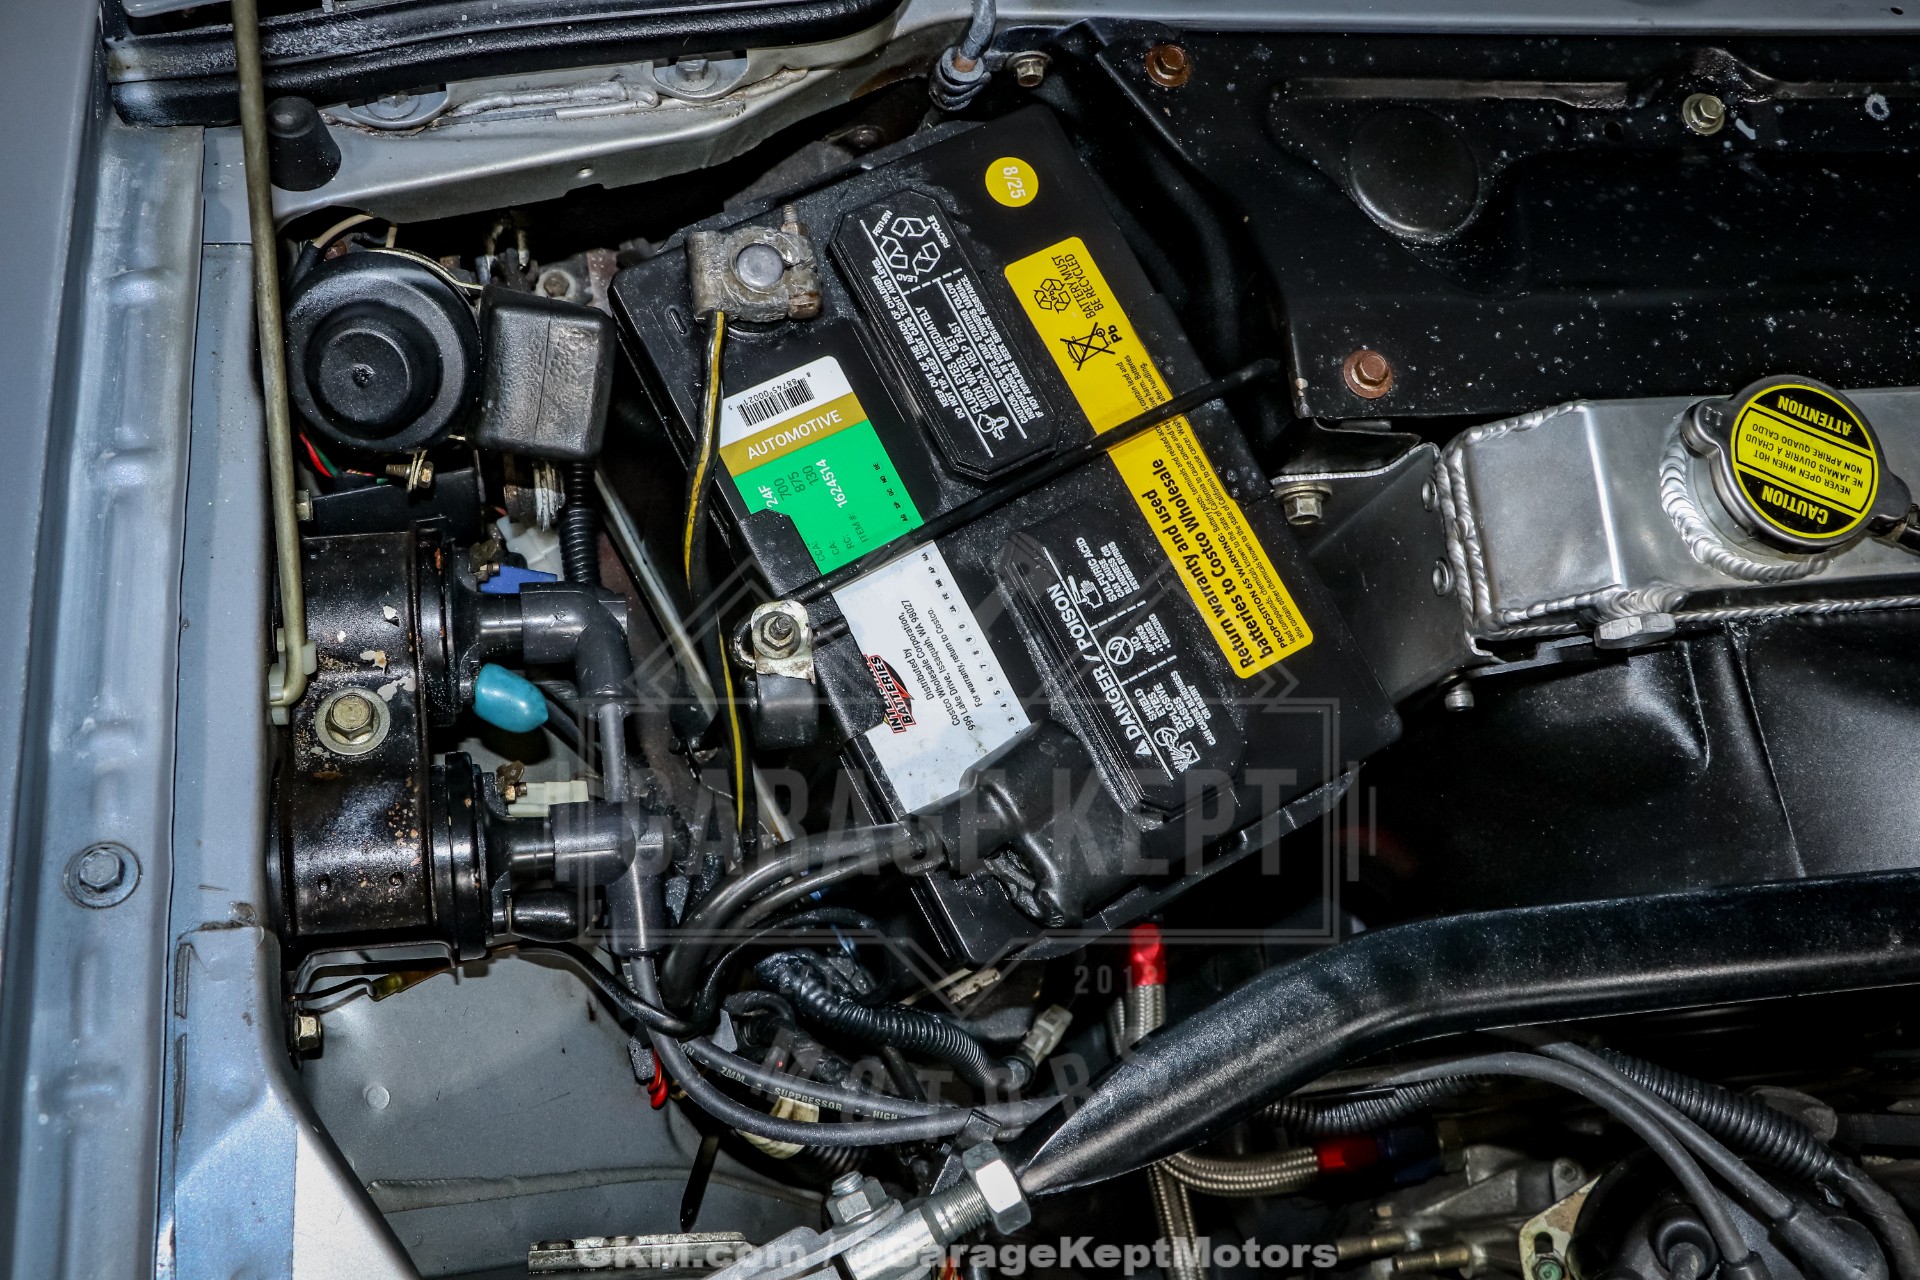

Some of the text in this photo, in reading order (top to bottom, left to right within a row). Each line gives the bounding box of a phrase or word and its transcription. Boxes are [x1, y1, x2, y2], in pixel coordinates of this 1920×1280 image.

[1001, 165, 1026, 199] 8/25
[872, 209, 893, 237] RETURN
[928, 213, 951, 249] RECYCLE
[896, 273, 916, 282] LEAD
[1051, 254, 1096, 319] BATTERY MUST
[1063, 253, 1104, 311] BE RECYCLED
[944, 280, 966, 310] FOLLOW
[1047, 290, 1058, 301] Pb
[870, 255, 966, 420] DO NOT TIP. KEEP VENT CAPS TIGHT AND LEVEL
[965, 308, 984, 339] STARTING
[968, 307, 990, 338] OWNERS
[1106, 324, 1122, 343] Pb
[873, 273, 950, 408] KEEP OUT OF THE REACH OF CHILDREN
[958, 273, 1044, 418] IF NOT AVAILABLE SEEK SERVICE ASSISTANCE.
[976, 340, 994, 361] JUMP
[984, 335, 1005, 364] VEHICLE
[914, 303, 982, 415] FLUSH EYES IMMEDIATELY
[944, 332, 991, 410] WITH WATER. GET
[946, 318, 1001, 406] MEDICAL HELP FAST
[988, 359, 1004, 379] SAFE
[998, 363, 1010, 373] IN
[1115, 361, 1126, 373] and
[997, 377, 1012, 394] FOR
[1122, 372, 1134, 386] lead
[1003, 371, 1036, 420] INSTRUCTIONS
[1130, 385, 1146, 406] contain
[1775, 393, 1854, 438] ATTENTION
[747, 409, 841, 460] AUTOMOTIVE
[1745, 433, 1774, 451] CHAUD
[1751, 423, 1779, 440] CALDO
[1171, 456, 1182, 468] and
[1754, 449, 1850, 495] NEVER OPEN WHEN HOT
[1784, 449, 1816, 469] OUVRIR
[1812, 448, 1842, 466] APRIRE
[1818, 463, 1850, 482] JAMAIS
[1843, 461, 1862, 474] NON
[772, 476, 792, 501] 700
[786, 470, 807, 493] 875
[800, 464, 819, 486] 130
[815, 458, 848, 508] 1624514
[1179, 467, 1198, 495] terminals
[1852, 477, 1863, 488] NE
[757, 483, 778, 508] 24F
[1759, 484, 1830, 526] CAUTION
[850, 521, 869, 542] ITEM
[1204, 511, 1220, 532] Battery
[1073, 535, 1118, 603] SULFURIC ACID
[1099, 543, 1132, 594] BLINDNESS OR
[1106, 539, 1141, 591] SEVERE BURNS
[1149, 458, 1274, 658] batteries to Costco Wholesale
[1216, 532, 1246, 578] WARNING:
[1097, 557, 1125, 598] CAN CAUSE
[1140, 488, 1255, 668] Return warranty and used
[1241, 577, 1253, 589] 65
[1045, 581, 1091, 651] POISON
[1147, 612, 1171, 645] SMOKING
[1249, 589, 1288, 648] PROPOSITION
[940, 633, 949, 642] to
[1128, 634, 1143, 651] NO
[1134, 623, 1156, 653] SPARKS
[1142, 619, 1164, 649] FLAMES
[900, 598, 977, 731] 999 Lake Drive, Issaquah, WA 98027
[944, 641, 960, 663] return
[896, 612, 961, 726] Costco Wholesale Corporation,
[901, 647, 934, 700] Distributed by
[956, 662, 976, 694] warranty,
[868, 654, 913, 726] BATTERIES
[971, 694, 983, 707] For
[1090, 663, 1140, 741] DANGER
[1132, 686, 1158, 722] SHIELD
[1145, 690, 1167, 717] EYES
[1186, 683, 1212, 720] OR INJURY
[1152, 681, 1184, 733] EXPLOSIVE
[1171, 695, 1196, 729] GASES
[1175, 668, 1217, 746] CAN CAUSE BLINDNESS
[774, 1086, 843, 1112] SUPPRESSOR
[872, 1109, 899, 1122] HIGH
